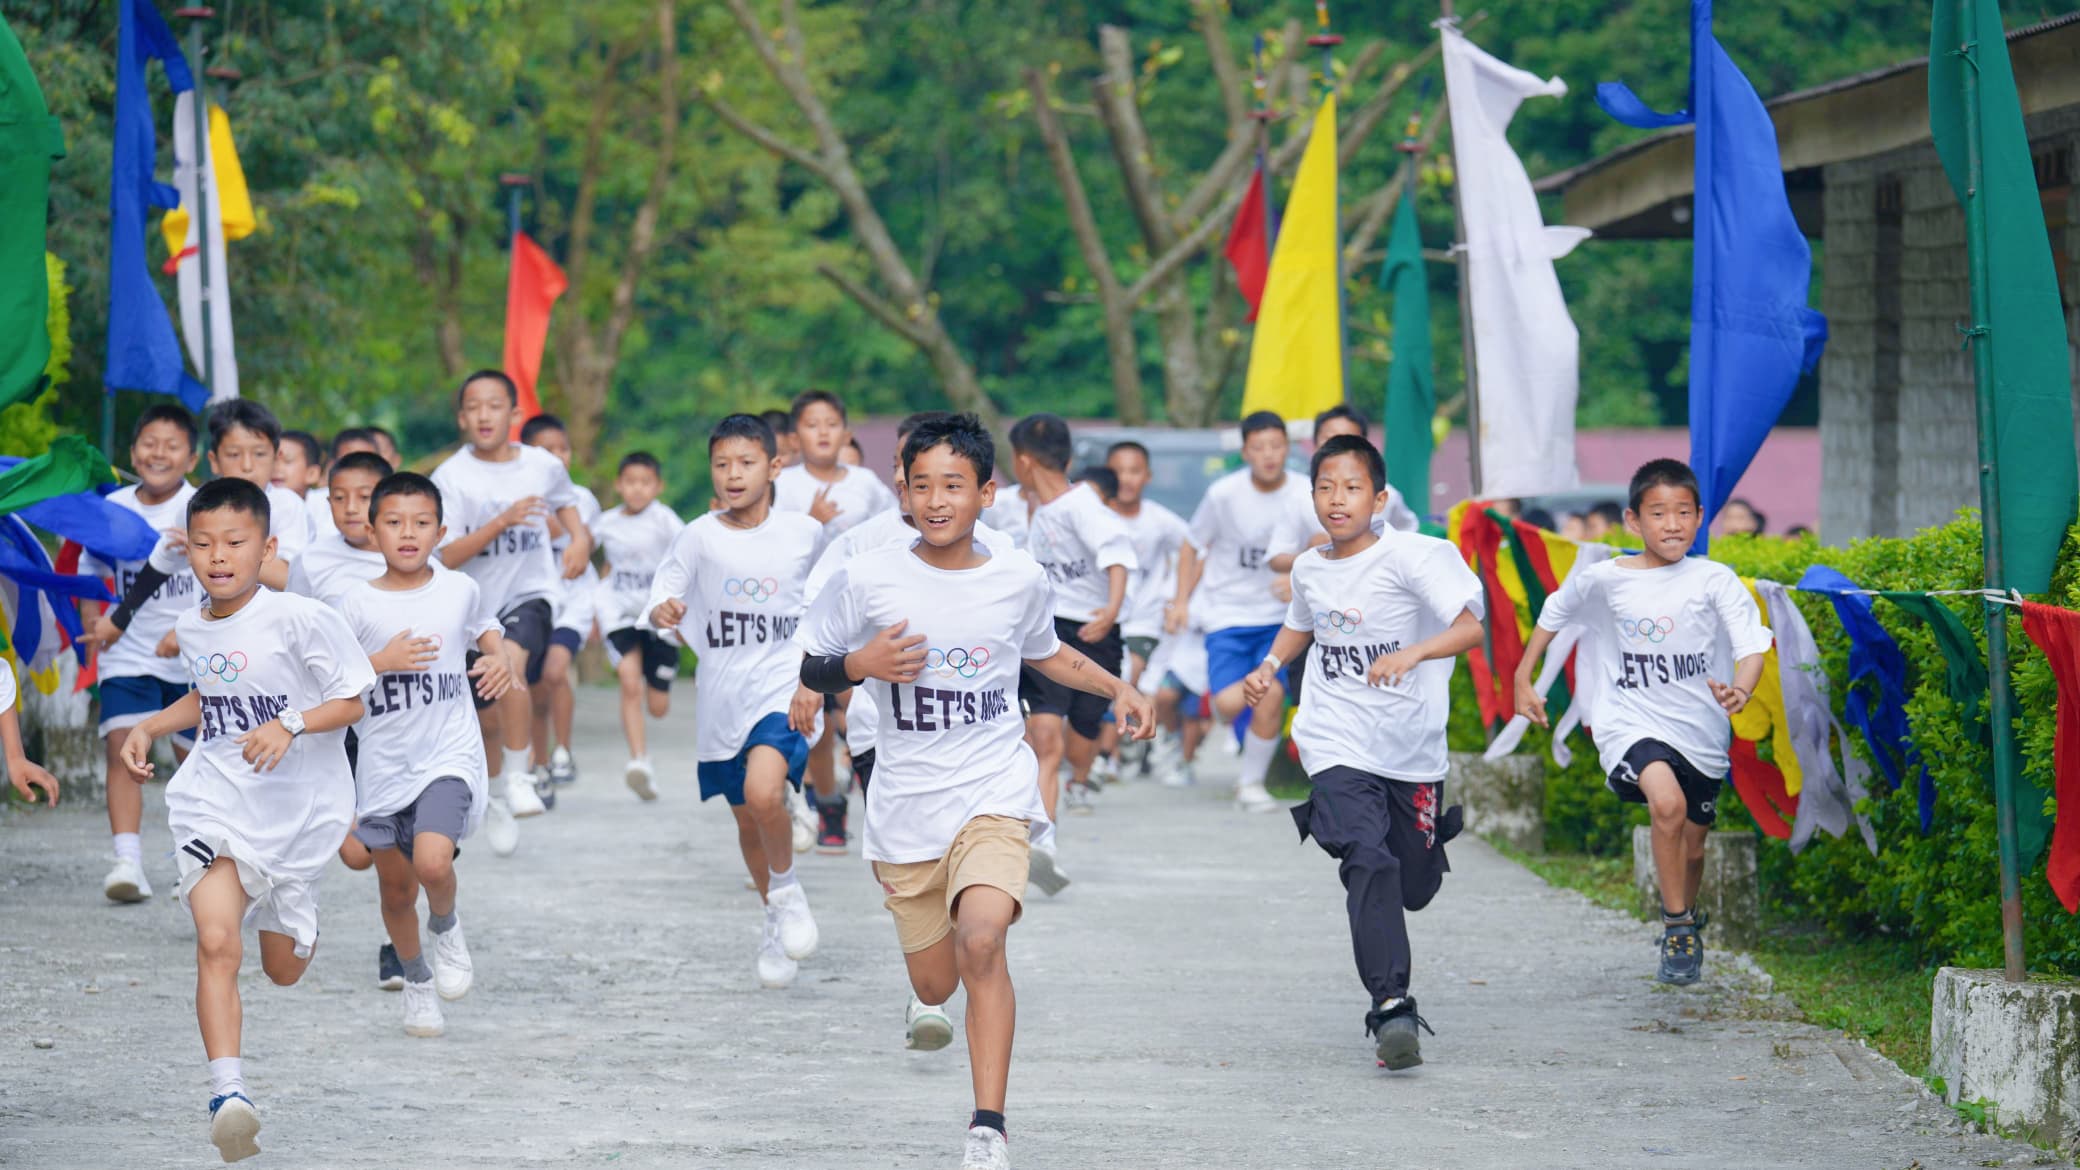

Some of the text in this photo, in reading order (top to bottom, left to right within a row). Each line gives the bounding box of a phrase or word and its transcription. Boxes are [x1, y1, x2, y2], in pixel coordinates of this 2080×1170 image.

[1672, 652, 1706, 681] MOVE
[369, 672, 461, 717] LET'S MOVE
[891, 682, 977, 732] LET'S
